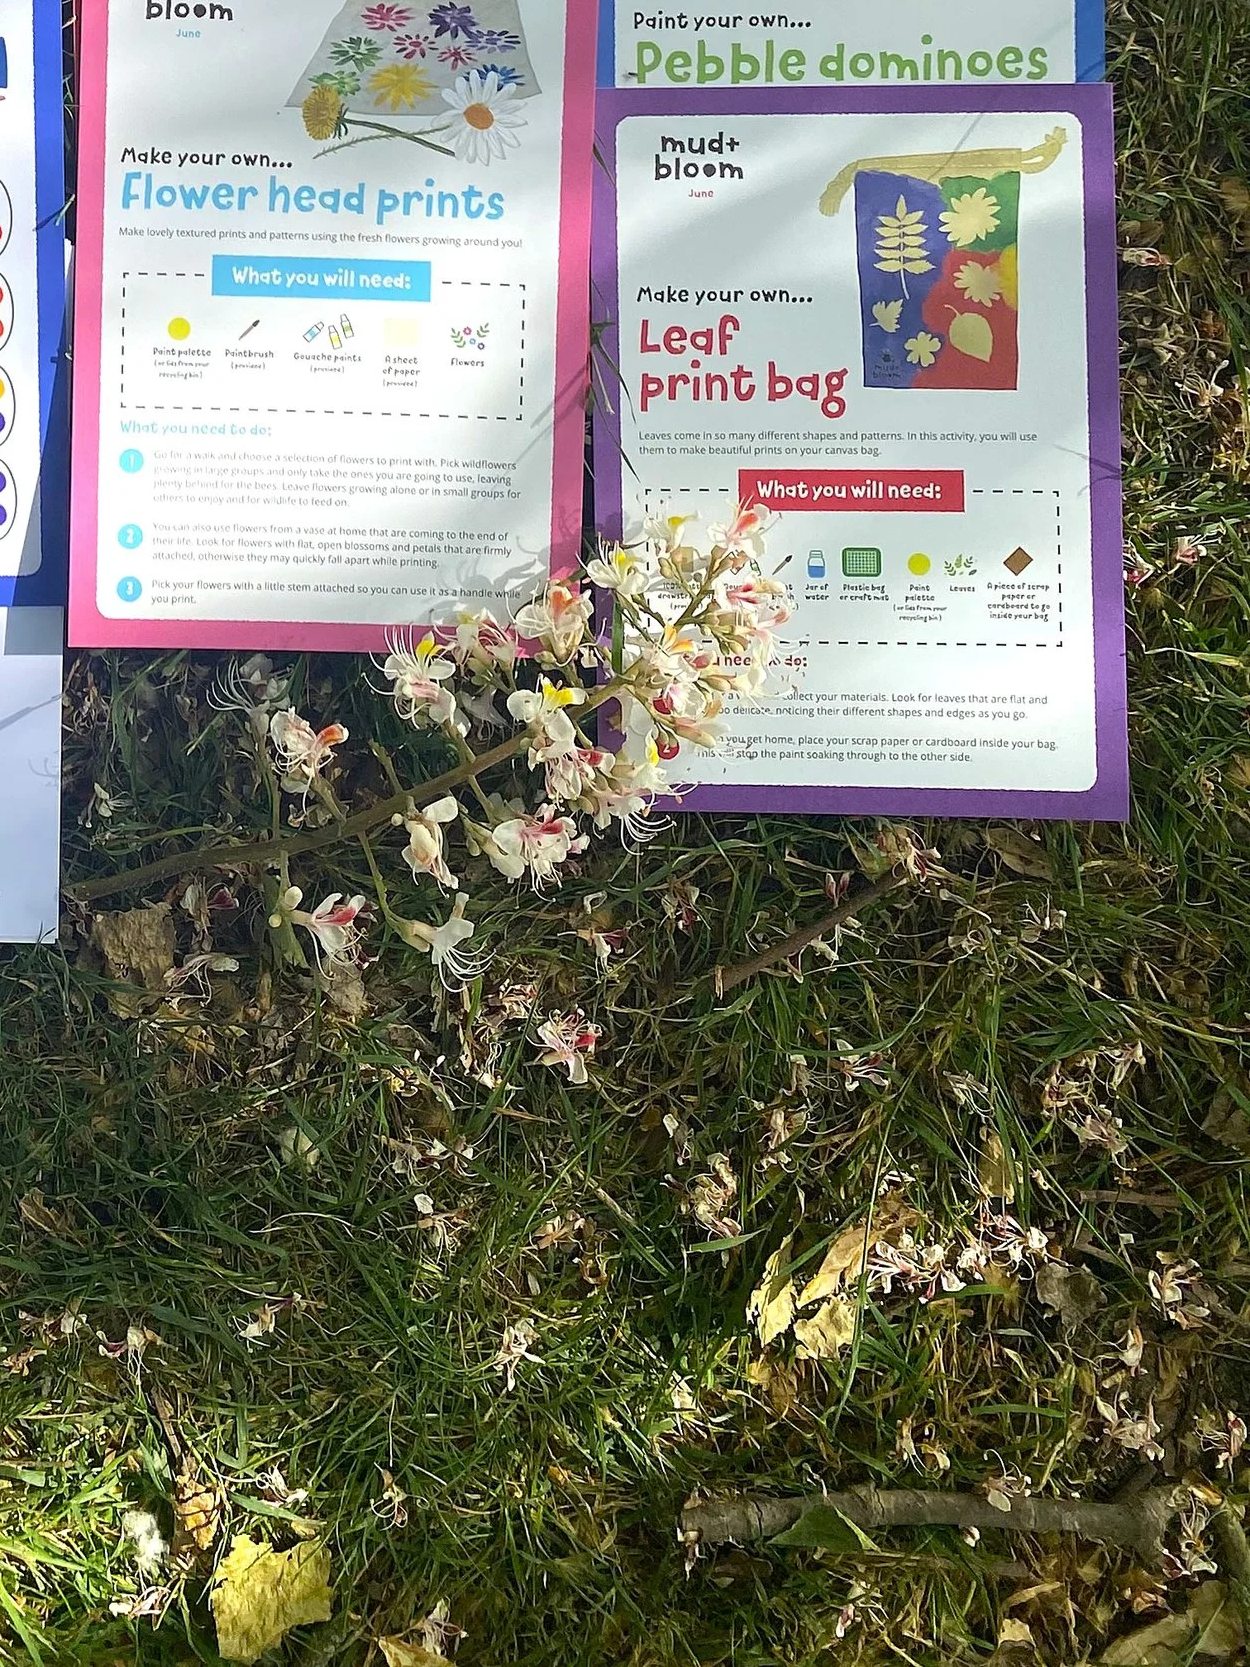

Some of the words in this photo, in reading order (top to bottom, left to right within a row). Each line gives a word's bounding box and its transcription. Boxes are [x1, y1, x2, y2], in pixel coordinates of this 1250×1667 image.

[633, 12, 688, 30] Paint
[694, 13, 743, 31] your
[749, 13, 811, 29] own...
[176, 29, 200, 38] June
[637, 40, 806, 84] Pebble
[819, 34, 1048, 82] dominoes
[661, 132, 739, 154] mud+
[121, 147, 172, 164] Make
[178, 151, 225, 167] your
[231, 151, 292, 168] own...
[654, 155, 743, 180] bloom
[121, 171, 258, 212] Flower
[268, 175, 364, 215] head
[376, 178, 504, 225] prints
[688, 189, 714, 198] June
[119, 227, 144, 236] Make
[147, 228, 173, 239] lovely
[176, 229, 215, 239] textured
[218, 229, 245, 241] prints
[249, 230, 266, 239] and
[269, 231, 309, 243] patterns
[312, 232, 336, 243] using
[340, 232, 356, 242] the
[358, 233, 382, 243] fresh
[385, 234, 419, 245] flowers
[422, 237, 461, 248] growing
[464, 237, 497, 246] around
[502, 238, 523, 249] you!
[232, 267, 281, 285] What
[285, 271, 320, 290] you
[324, 269, 354, 287] will
[359, 272, 411, 290] need:
[637, 286, 690, 303] Make
[695, 288, 743, 306] your
[750, 288, 813, 302] own...
[639, 314, 740, 355] Leaf
[640, 360, 755, 412] print
[768, 361, 849, 418] bag
[639, 432, 671, 441] Leaves
[703, 432, 711, 440] in
[728, 434, 755, 444] many
[758, 431, 800, 440] different
[802, 431, 837, 444] shapes
[840, 431, 857, 440] and
[861, 433, 903, 444] patterns.
[907, 432, 915, 440] In
[919, 431, 937, 440] this
[940, 431, 977, 444] activity,
[979, 434, 998, 444] you
[1001, 431, 1015, 440] will
[757, 480, 808, 497] What
[811, 483, 847, 502] you
[850, 480, 882, 497] will
[888, 480, 941, 498] need:
